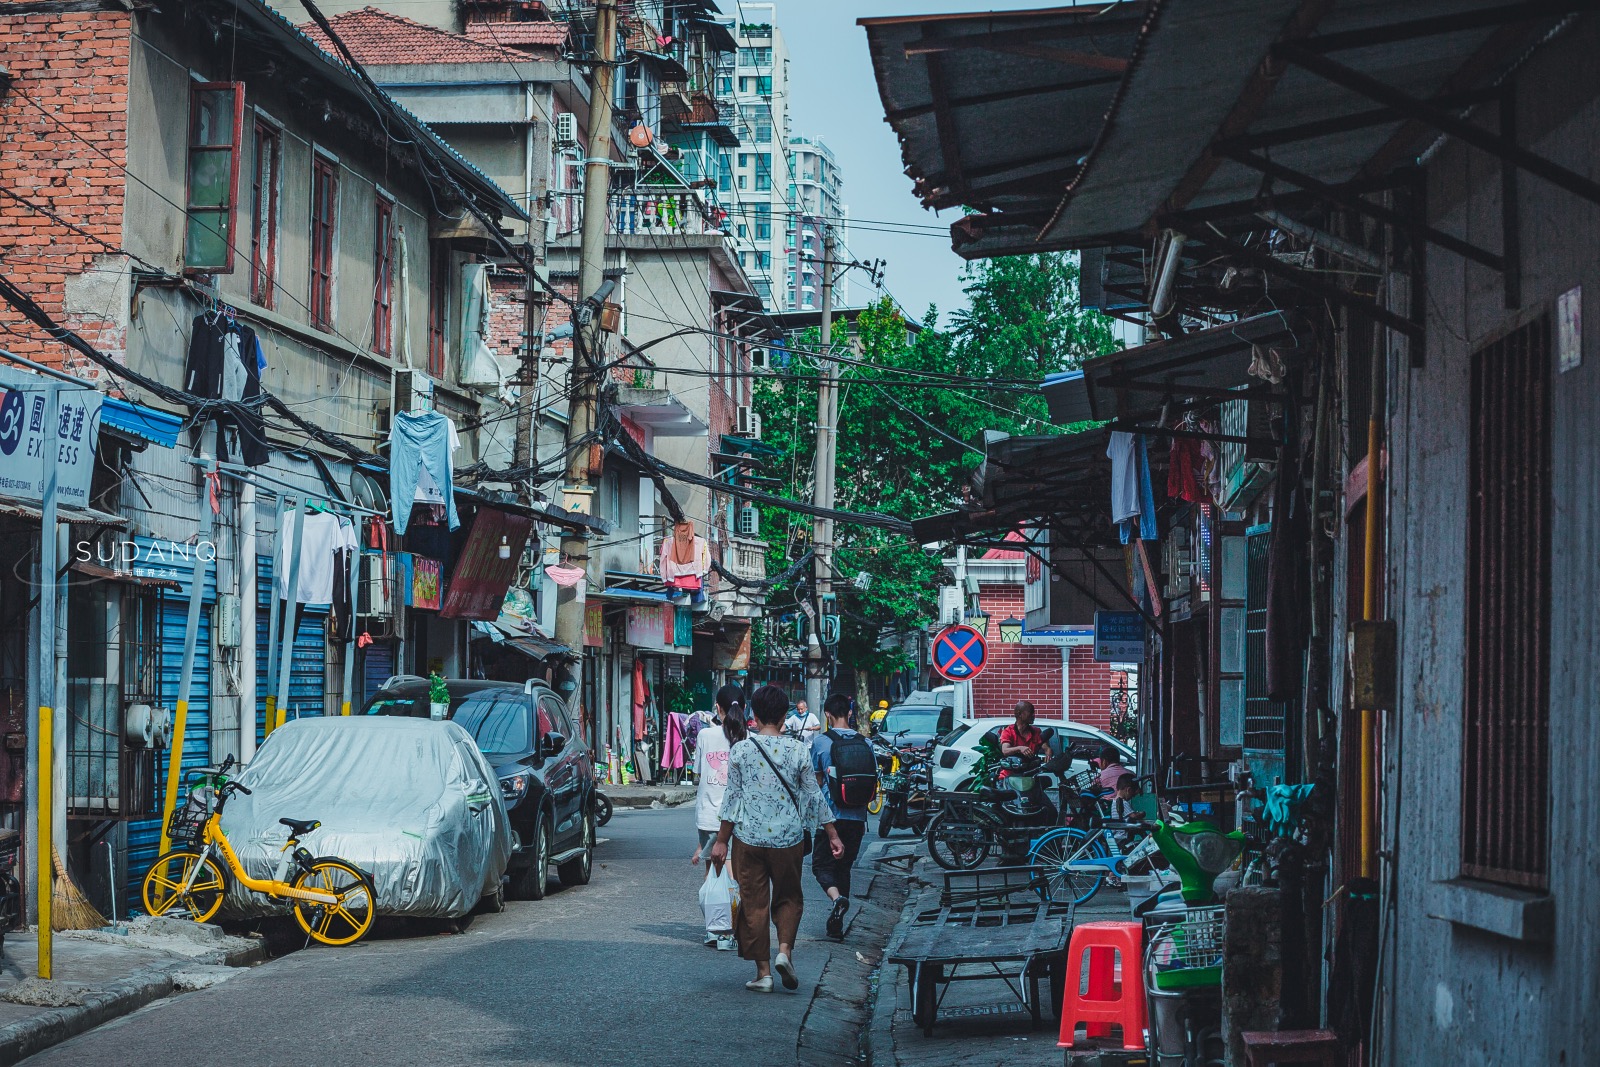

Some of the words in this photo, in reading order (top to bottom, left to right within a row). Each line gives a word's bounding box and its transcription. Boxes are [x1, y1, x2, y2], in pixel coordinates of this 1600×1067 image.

[29, 395, 85, 442] 圆速递
[27, 437, 79, 465] EXESS
